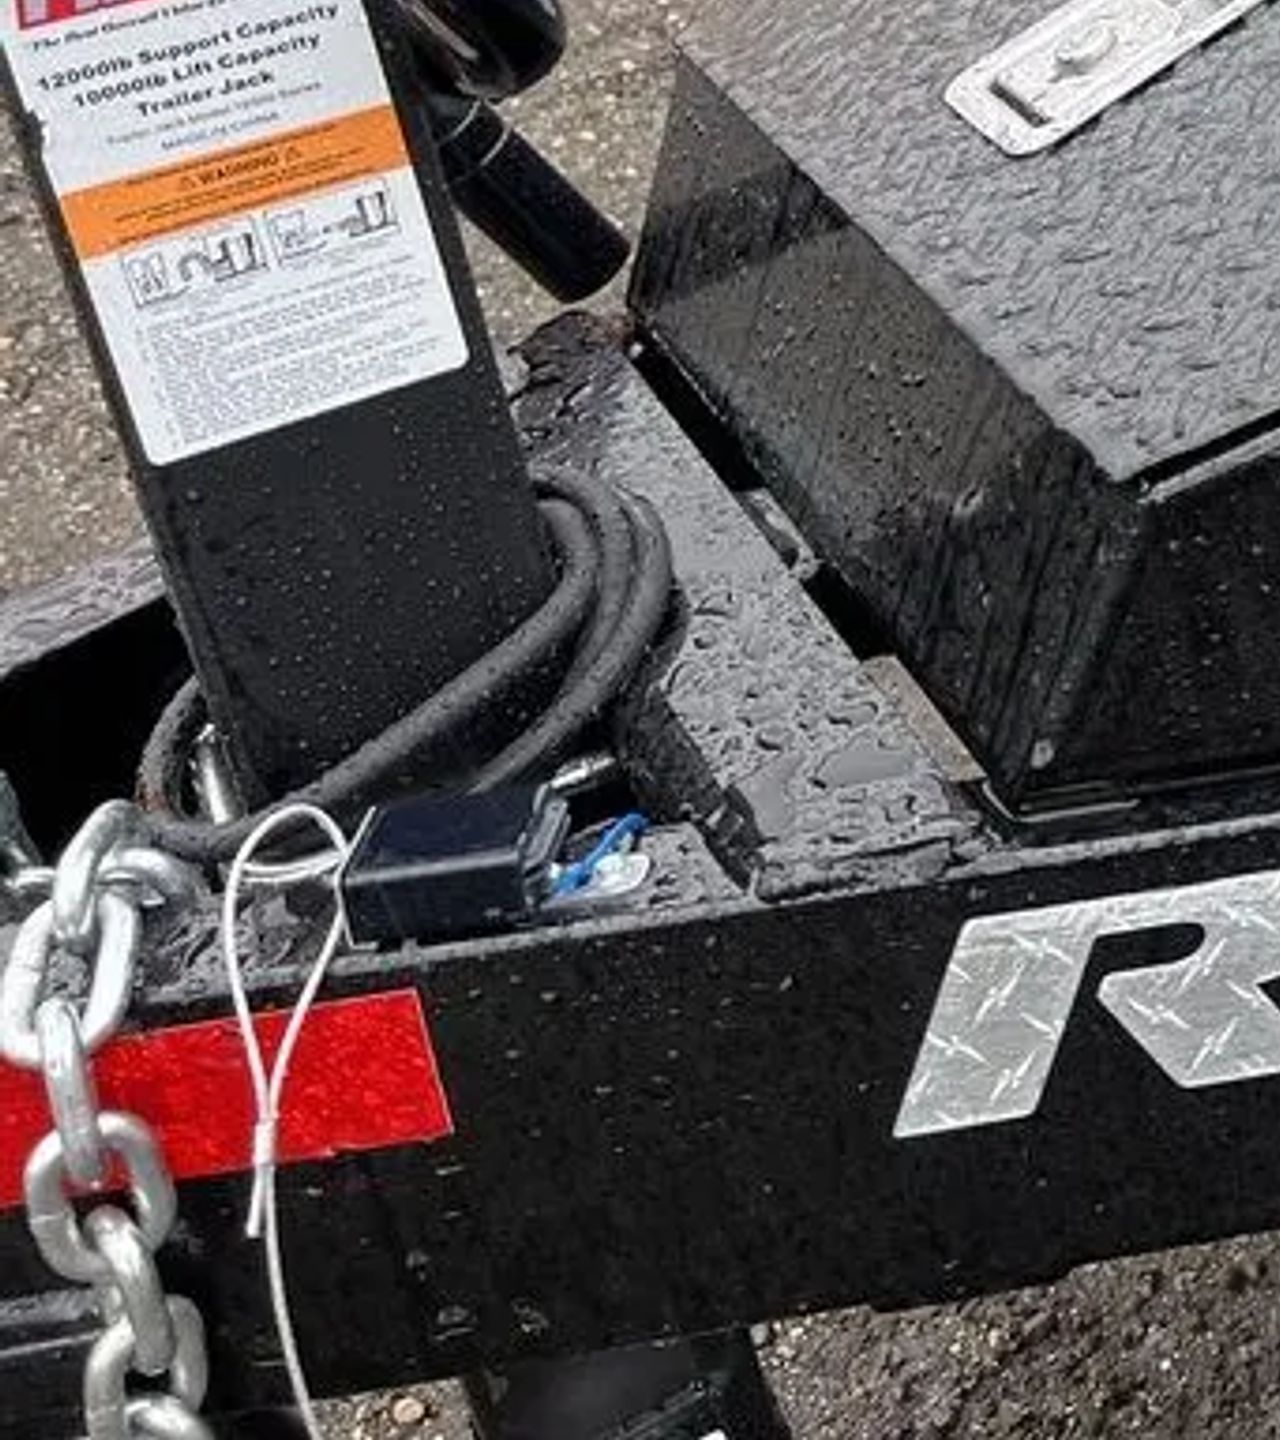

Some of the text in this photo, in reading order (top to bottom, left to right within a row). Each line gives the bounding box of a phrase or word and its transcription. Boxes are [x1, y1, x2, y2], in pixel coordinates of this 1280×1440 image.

[137, 31, 232, 67] Support
[236, 3, 340, 43] Capacity
[216, 33, 322, 71] Capacity
[137, 86, 214, 117] Trailer
[218, 68, 276, 96] Jack
